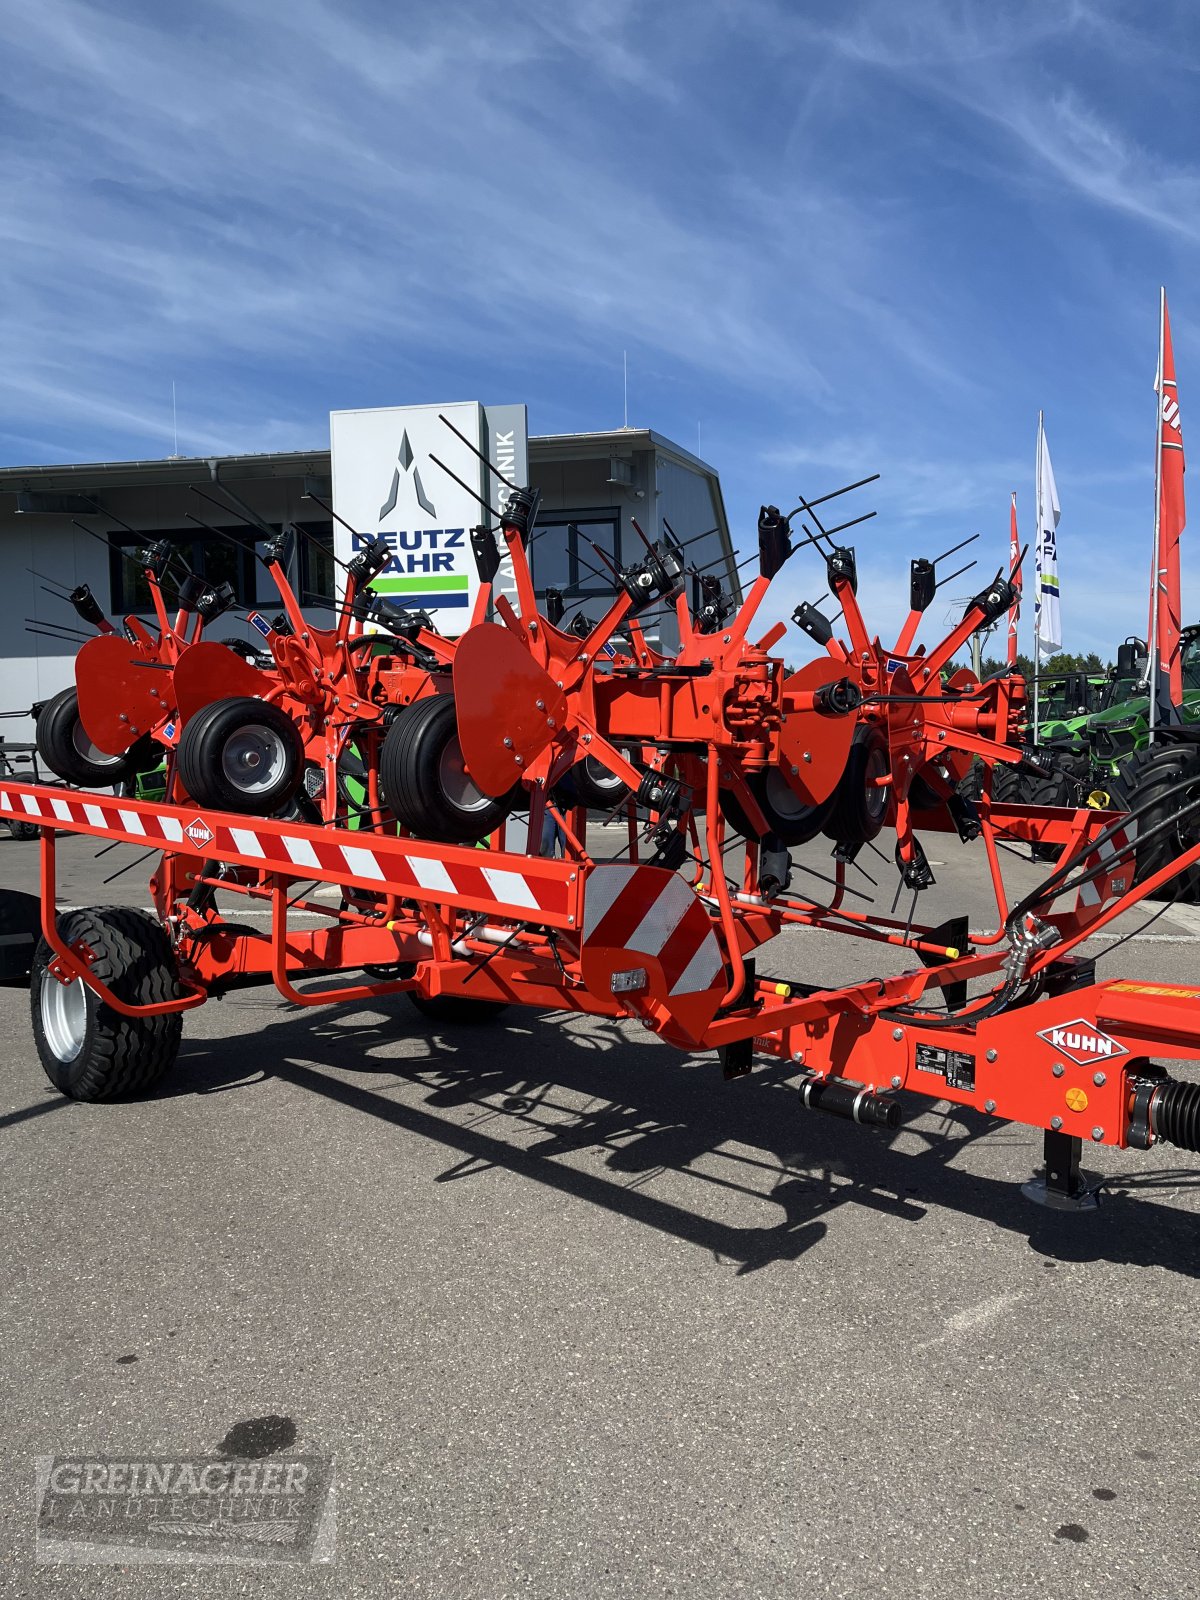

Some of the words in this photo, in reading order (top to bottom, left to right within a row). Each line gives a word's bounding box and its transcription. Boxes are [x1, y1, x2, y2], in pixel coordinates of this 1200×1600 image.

[351, 528, 465, 552] DEUTZ
[381, 552, 455, 574] AHR
[189, 826, 210, 840] KUHN
[1052, 1029, 1112, 1055] KUHN
